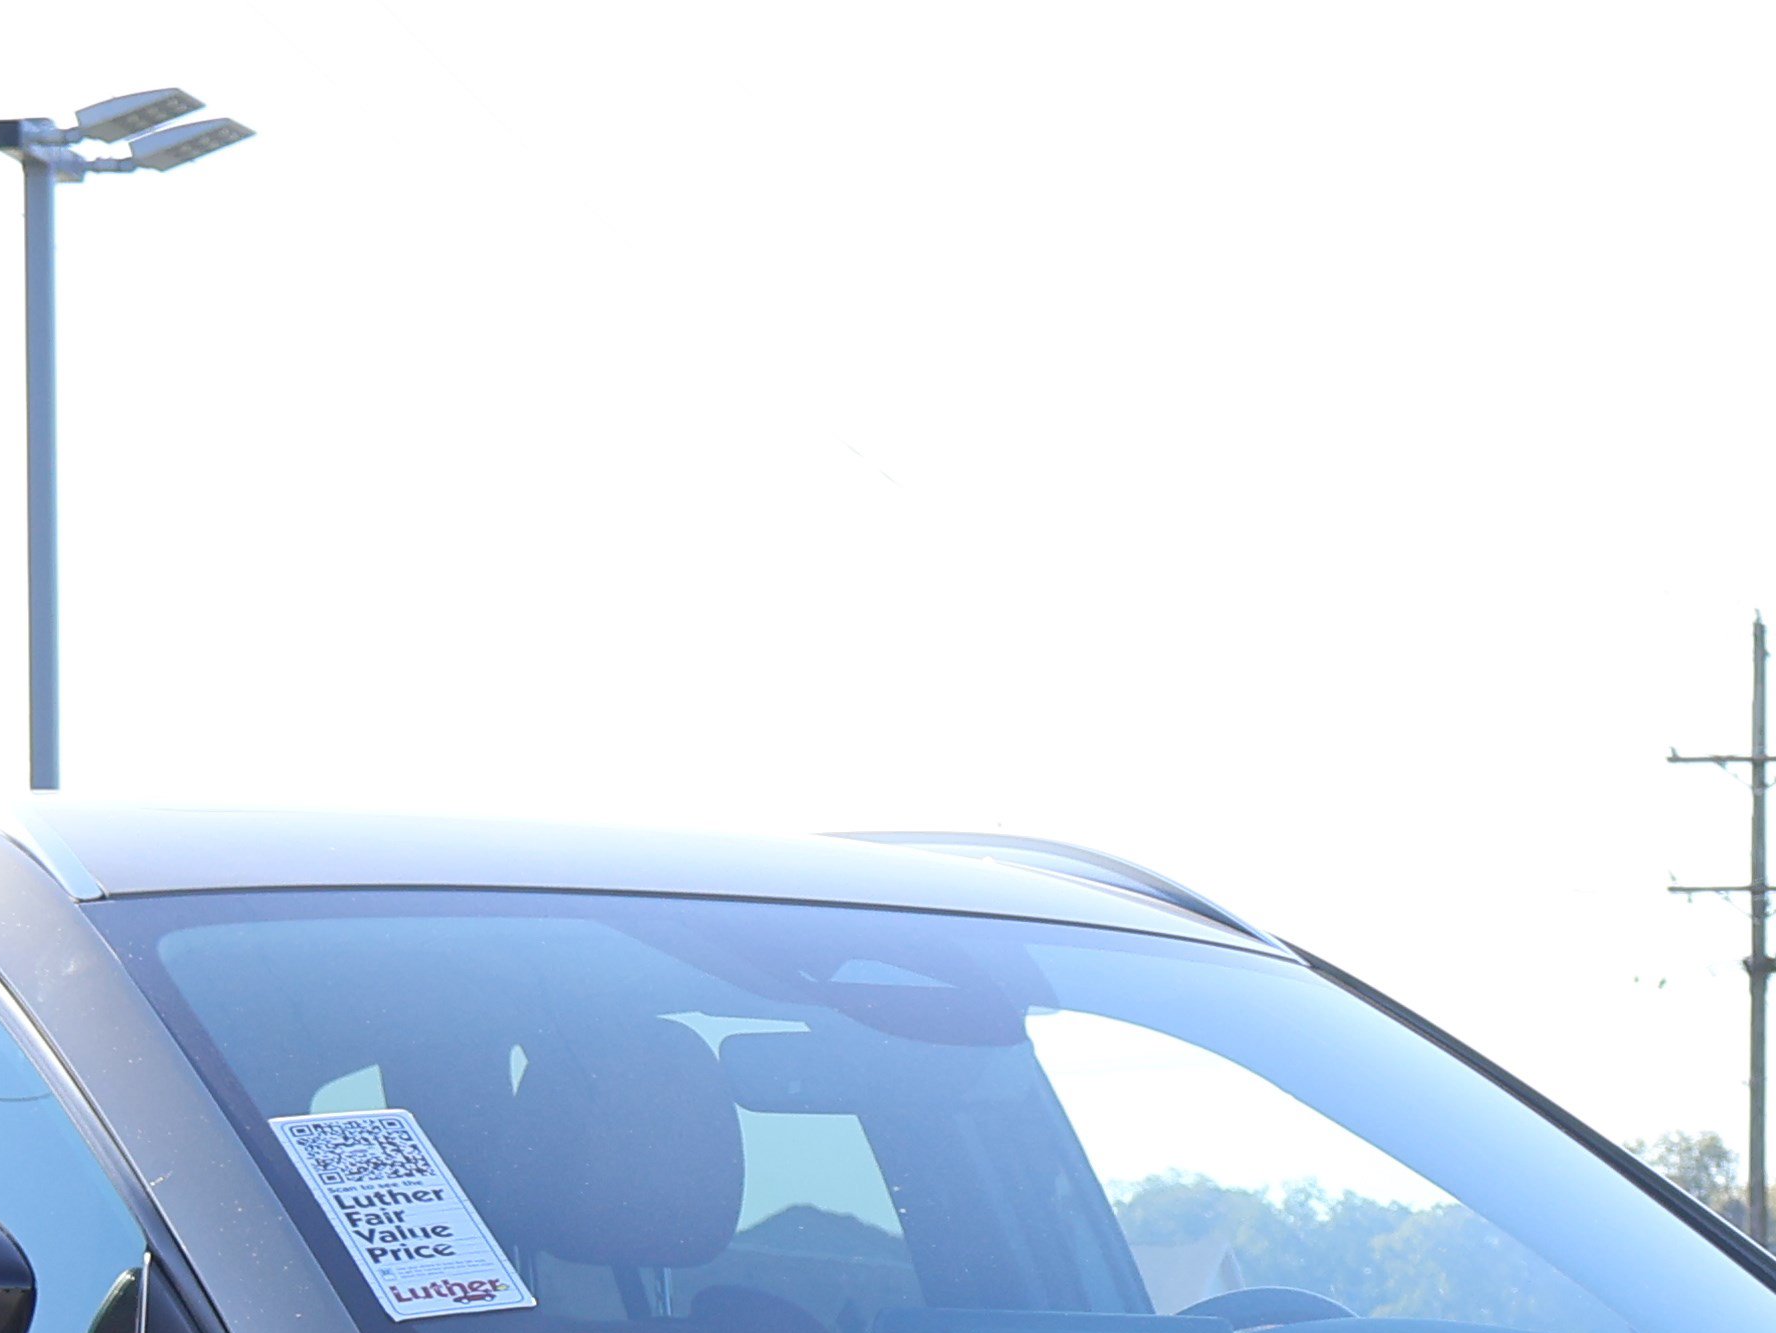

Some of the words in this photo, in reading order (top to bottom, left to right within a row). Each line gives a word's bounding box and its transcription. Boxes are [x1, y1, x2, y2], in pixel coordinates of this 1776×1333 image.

[333, 1189, 444, 1210] Luther
[344, 1207, 405, 1228] Fair
[352, 1225, 454, 1245] Value
[365, 1243, 456, 1264] Price
[388, 1279, 501, 1303] Luther
